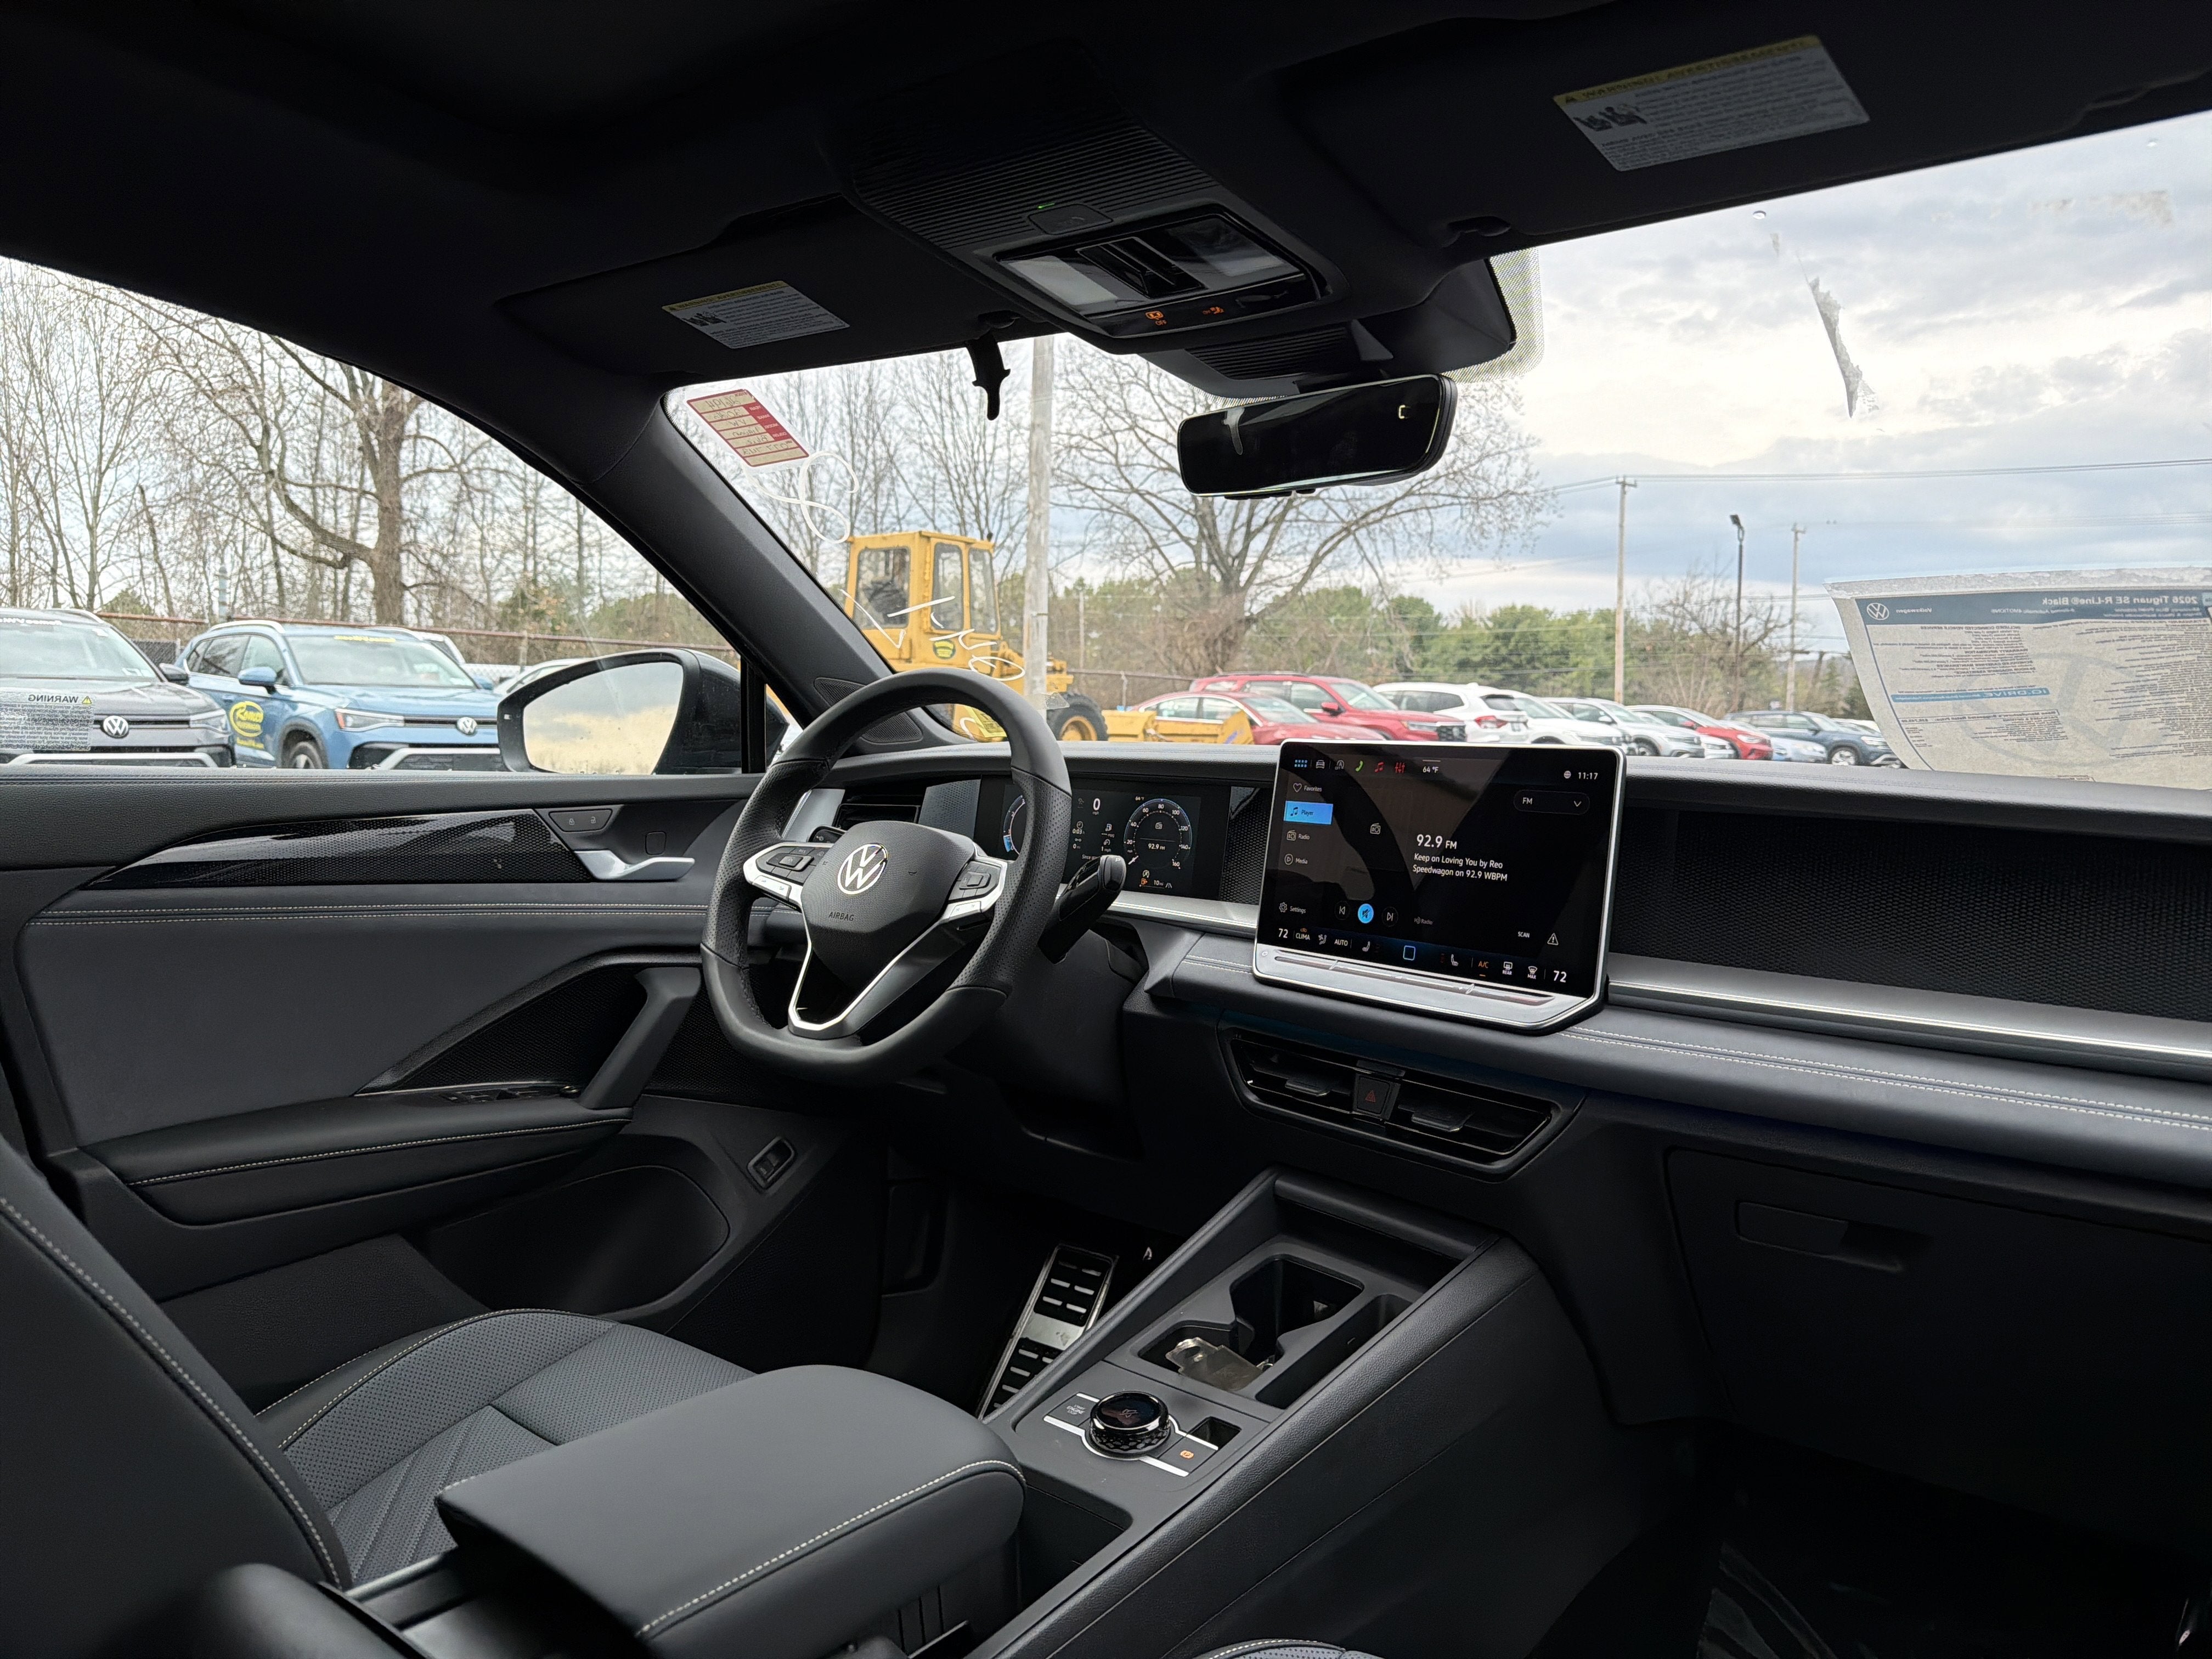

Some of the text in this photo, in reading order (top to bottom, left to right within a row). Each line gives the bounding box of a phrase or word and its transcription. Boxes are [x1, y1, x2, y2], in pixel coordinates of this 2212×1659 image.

[1578, 772, 1598, 780] 11:17
[1093, 798, 1101, 811] 0
[1417, 834, 1457, 850] 92.9 FM
[1414, 853, 1430, 863] Keep
[1442, 855, 1463, 867] Loving
[1465, 857, 1478, 867] You
[1479, 858, 1488, 870] by
[1489, 860, 1503, 869] Reo
[1412, 864, 1454, 877] Speedwagon
[1465, 870, 1482, 879] 92.9
[1484, 871, 1508, 882] WBPM
[1290, 906, 1306, 914] Settings
[828, 911, 855, 922] AIRBAG
[1278, 928, 1288, 939] 72
[1295, 933, 1310, 941] CLIMA
[1477, 961, 1489, 969] A/C
[1553, 970, 1567, 983] 72
[1066, 1406, 1085, 1414] ENGINE
